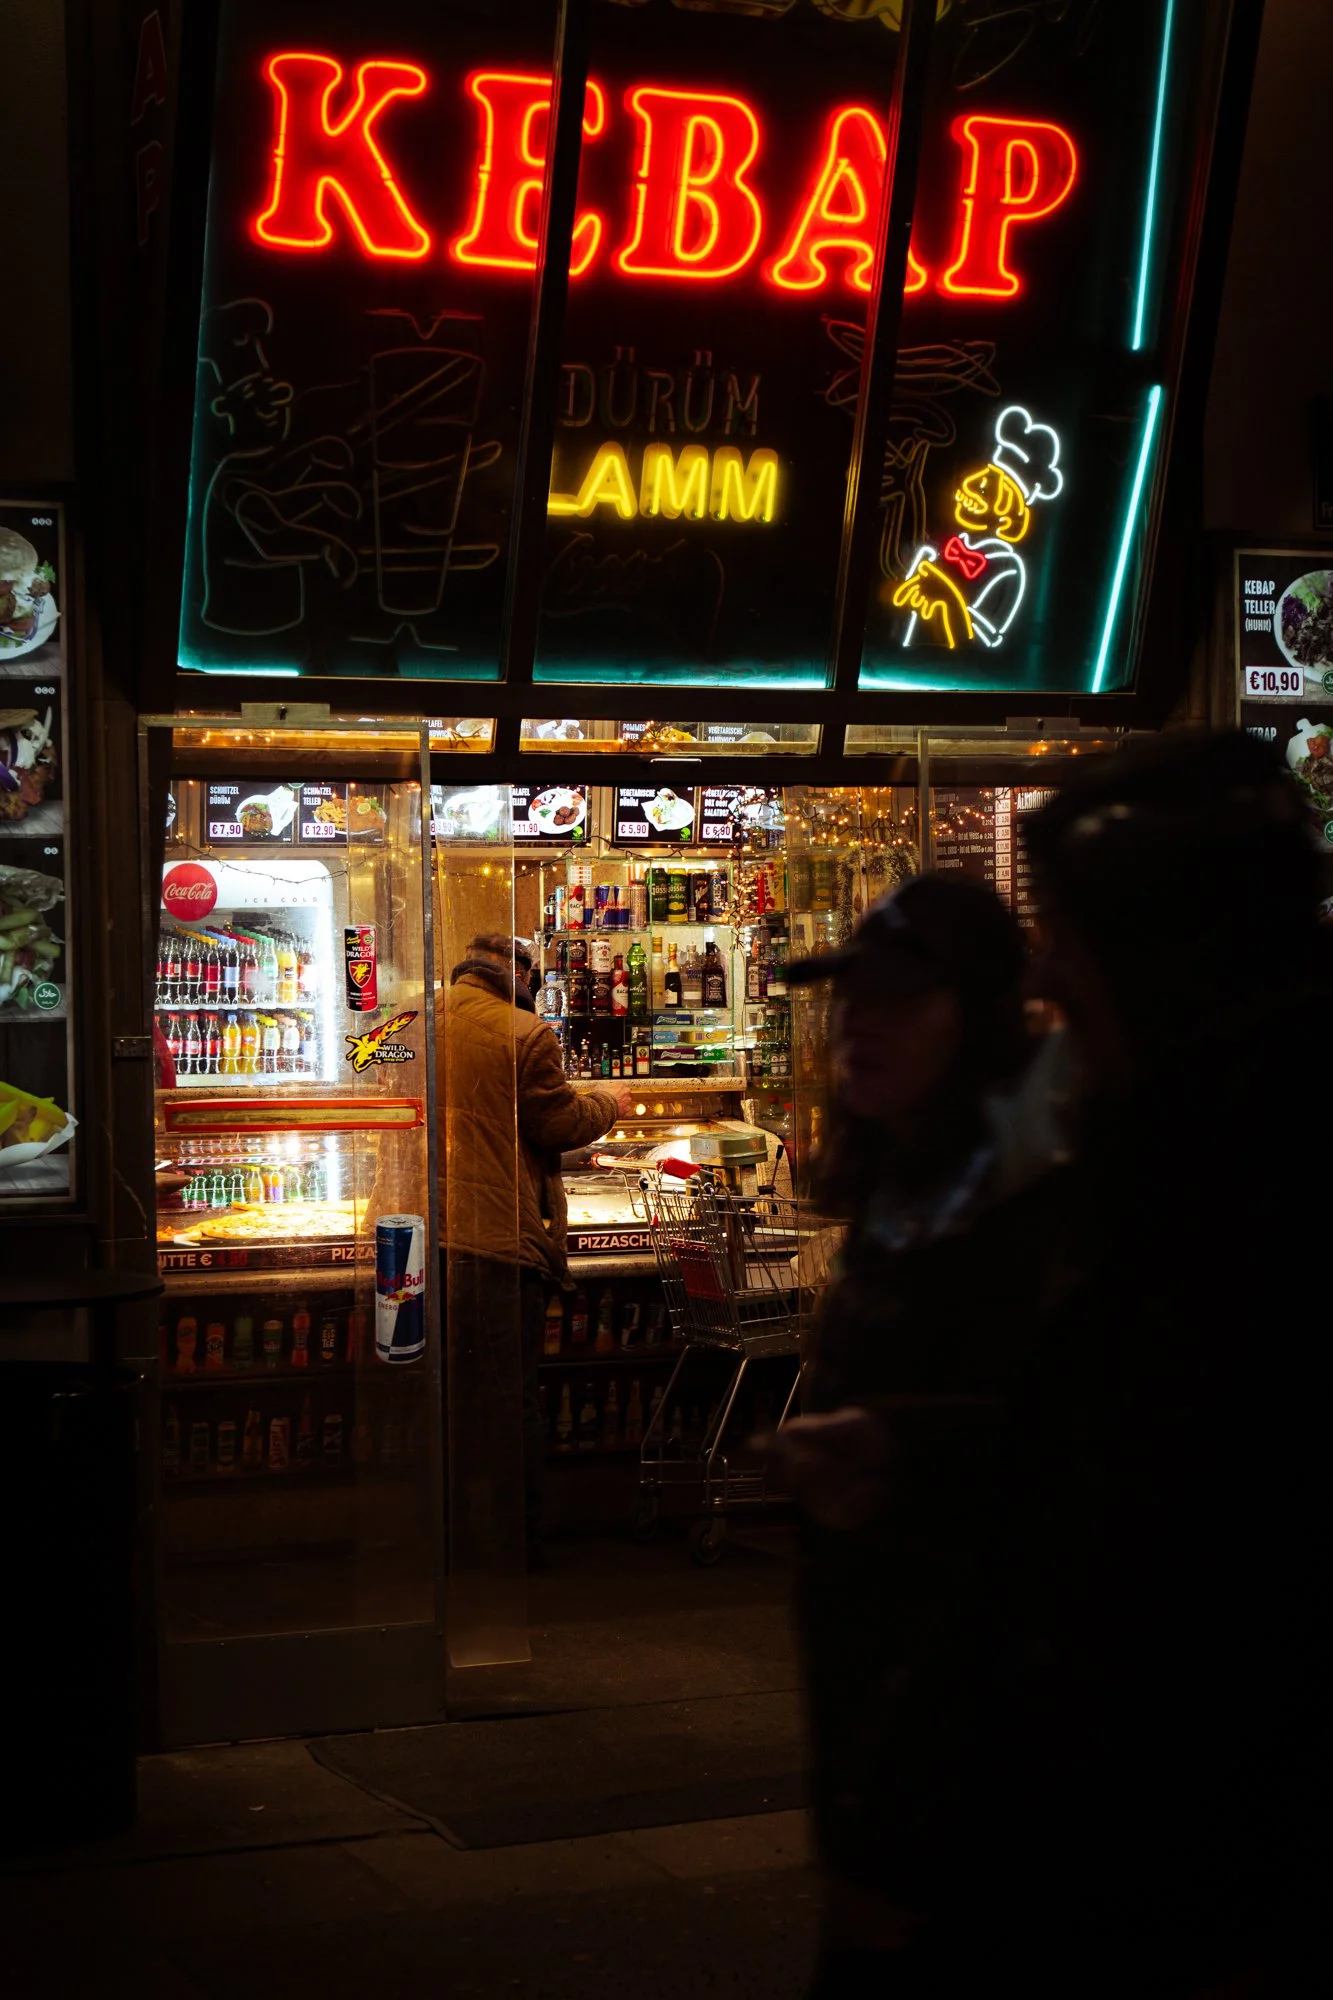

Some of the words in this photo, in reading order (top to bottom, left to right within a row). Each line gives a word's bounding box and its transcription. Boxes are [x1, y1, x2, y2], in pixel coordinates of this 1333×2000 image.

[253, 50, 1080, 299] KEBAP
[559, 345, 762, 436] DÜRÜM
[1244, 579, 1275, 596] KEBAP
[1244, 600, 1276, 615] TELLER
[1250, 670, 1299, 694] €10,90
[622, 723, 646, 732] POMMES
[209, 786, 240, 795] SCHNITZEL
[303, 787, 332, 796] SCHNITZEL
[511, 787, 531, 796] ALAFEL
[209, 795, 231, 805] DÜRÜM
[303, 797, 321, 806] TELLER
[511, 797, 527, 806] ELLER
[164, 882, 215, 901] Coca-Cola
[244, 896, 268, 904] ICE
[346, 950, 375, 958] DRAGON
[375, 1050, 414, 1059] DRAGON
[331, 1247, 376, 1261] PIZZA
[200, 1253, 213, 1267] €
[403, 1268, 425, 1288] Bull
[377, 1301, 399, 1312] ENERG
